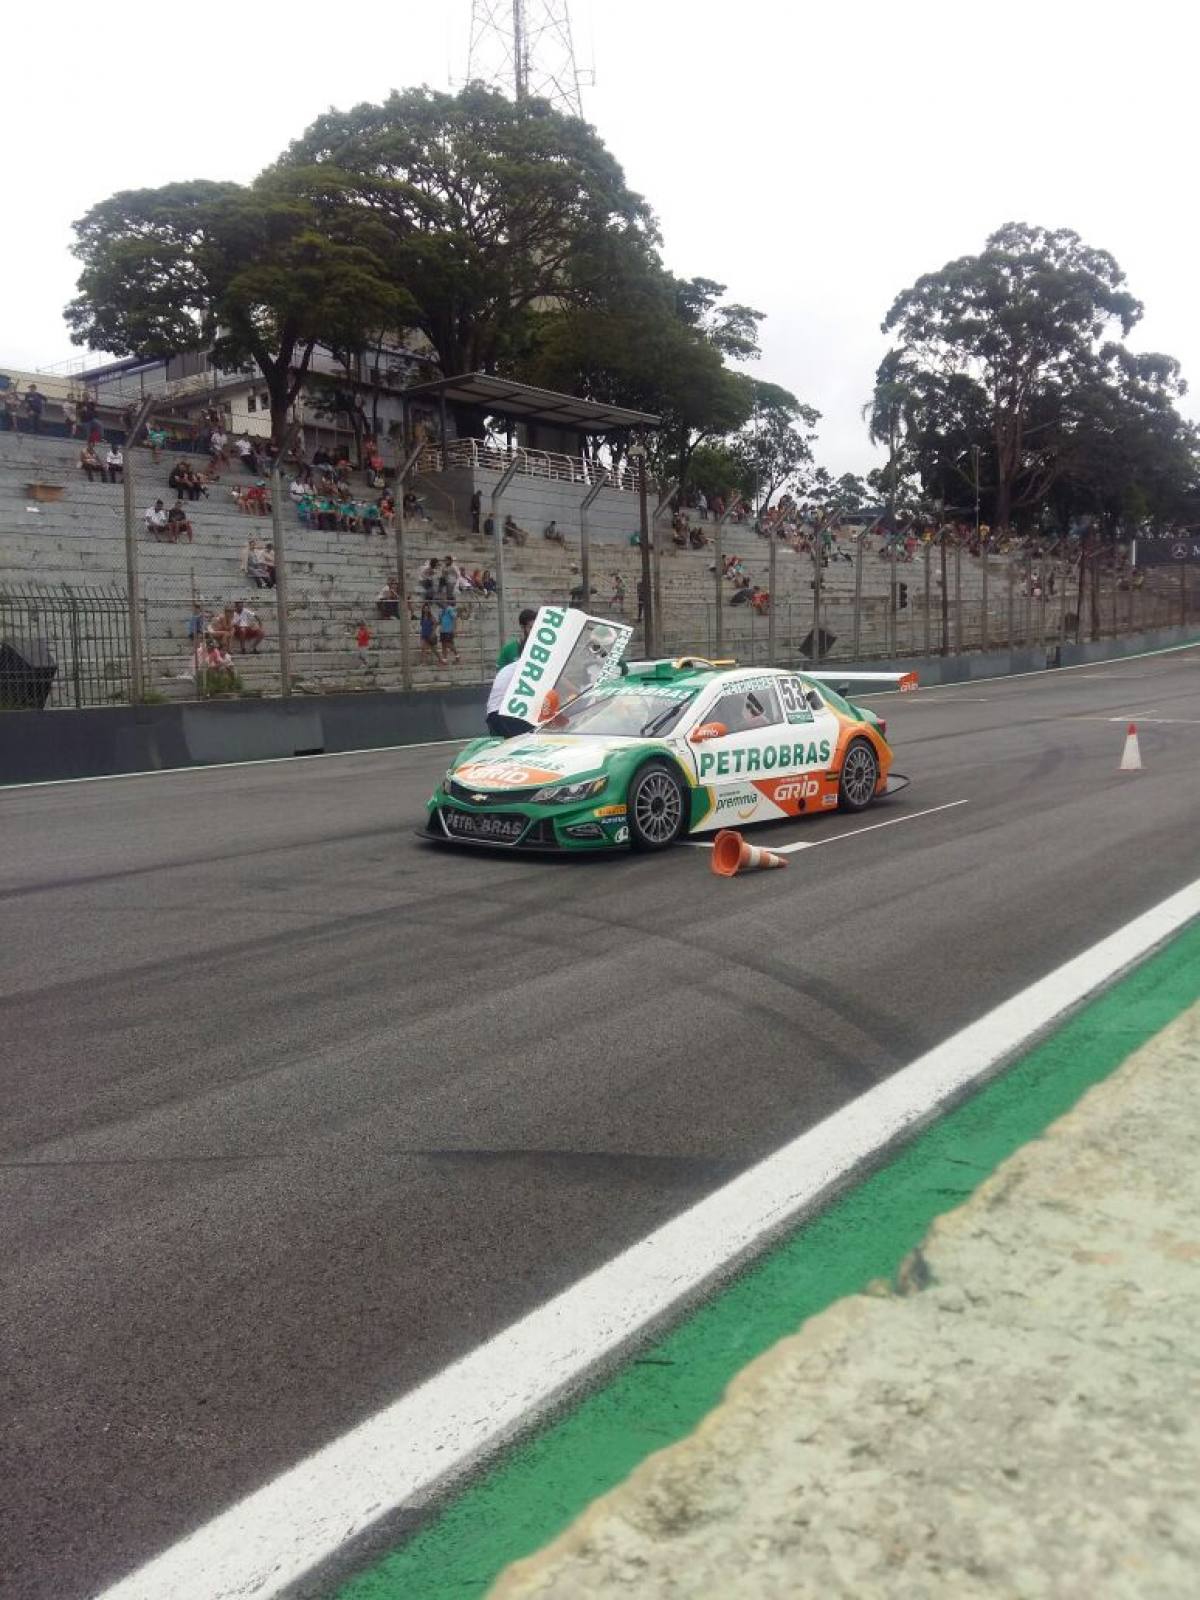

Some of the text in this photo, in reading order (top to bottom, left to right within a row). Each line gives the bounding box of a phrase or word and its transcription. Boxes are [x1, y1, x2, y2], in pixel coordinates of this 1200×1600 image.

[778, 678, 807, 711] 53
[700, 739, 830, 777] PETROBRAS
[774, 779, 819, 800] GRID
